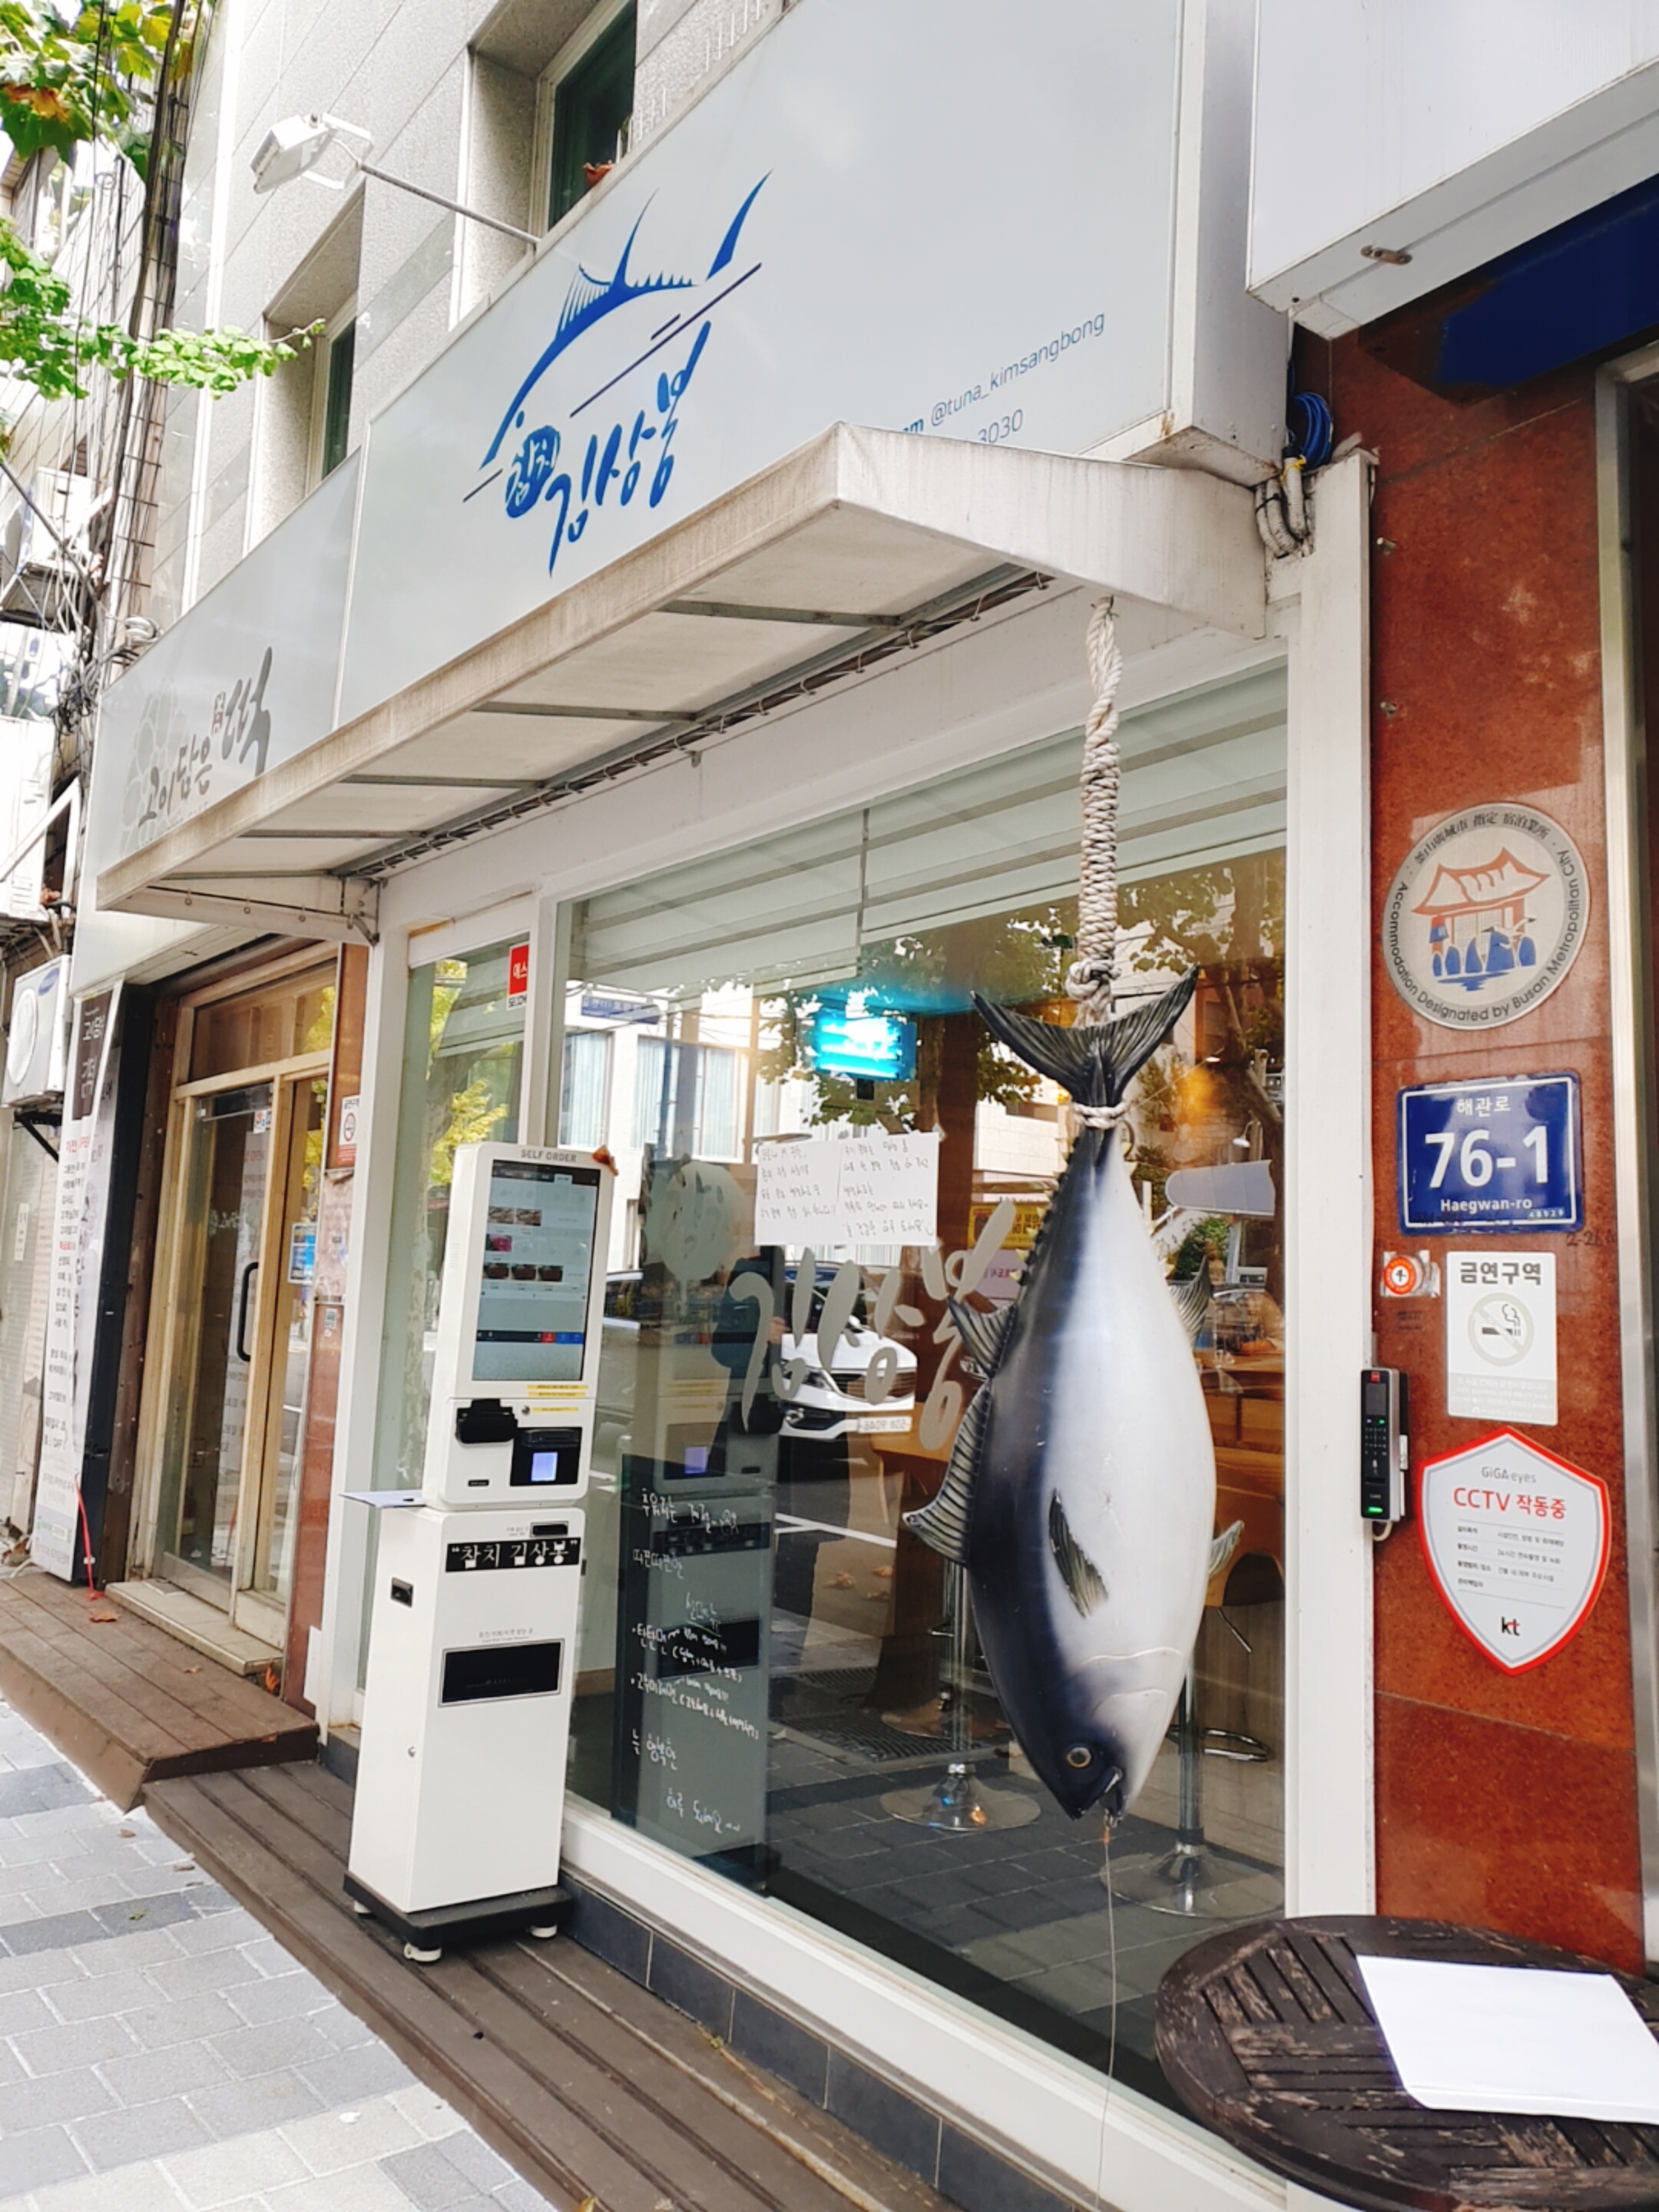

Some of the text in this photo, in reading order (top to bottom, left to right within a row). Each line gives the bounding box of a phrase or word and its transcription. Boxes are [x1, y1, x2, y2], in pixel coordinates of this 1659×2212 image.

[930, 313, 1105, 426] @tuna_kimsangbong
[546, 320, 712, 579] 김상봉
[1388, 849, 1581, 1022] Accommodation Designated by Busan Metropolitan City
[1456, 1095, 1512, 1118] 해관로
[521, 1149, 577, 1163] SELF ORDER
[1425, 1124, 1549, 1189] 76-1
[1440, 1197, 1533, 1215] Haegwan-ro
[1459, 1261, 1542, 1286] 금연구역
[1453, 1487, 1567, 1520] CCTV 작동중
[1501, 1617, 1521, 1636] kt
